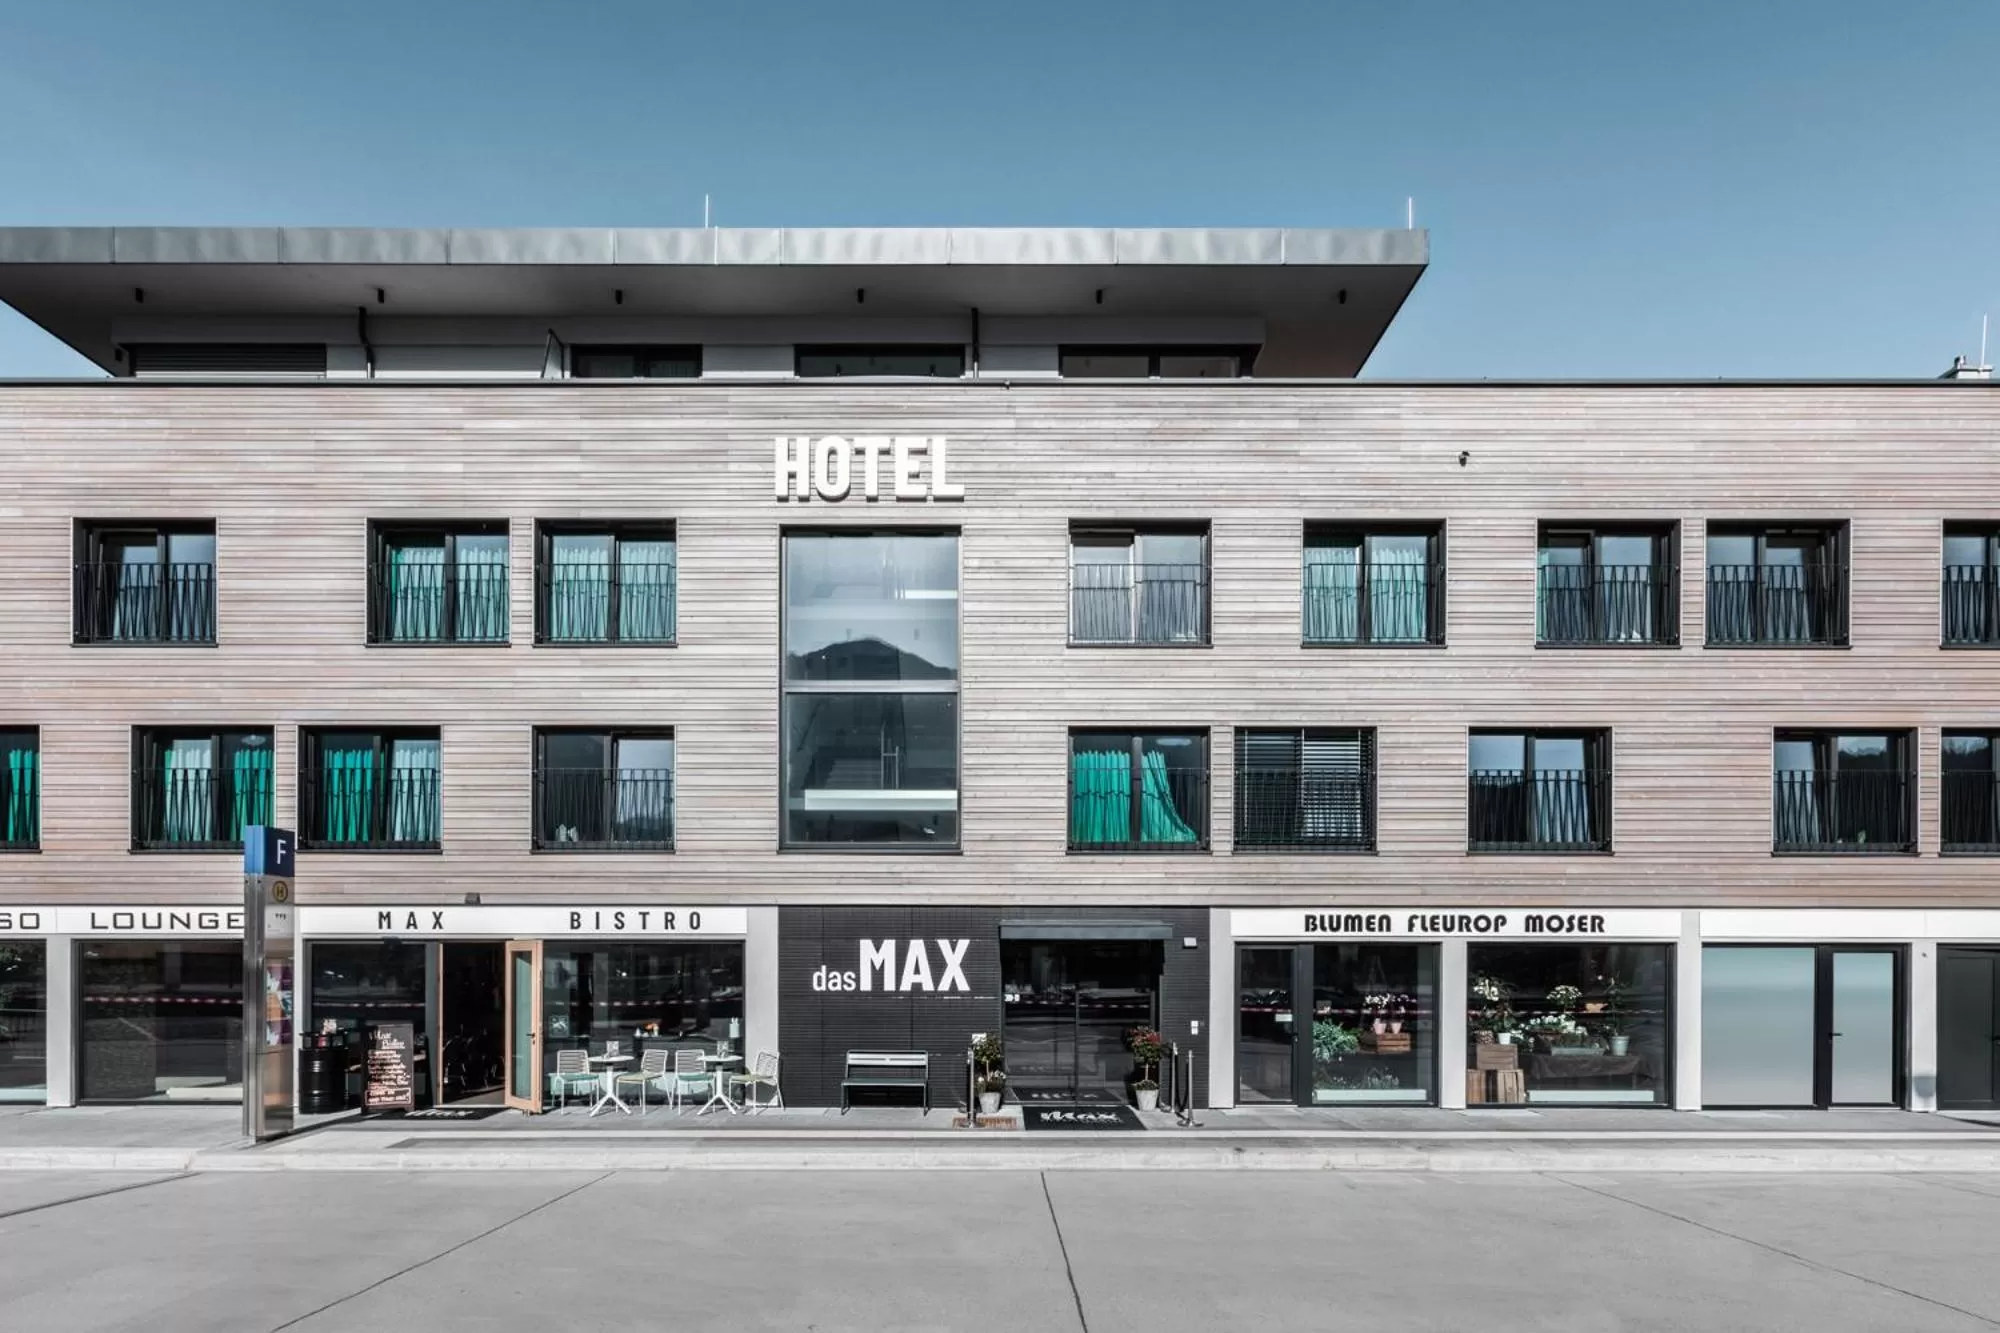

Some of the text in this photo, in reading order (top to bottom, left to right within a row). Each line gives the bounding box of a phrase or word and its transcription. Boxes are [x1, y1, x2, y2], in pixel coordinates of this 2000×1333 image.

[775, 436, 965, 501] HOTEL
[277, 840, 286, 864] F
[92, 913, 244, 929] LOUNGE
[379, 912, 700, 930] MAX BISTRO
[1305, 915, 1604, 933] BLUMEN FLEUROP MOSER
